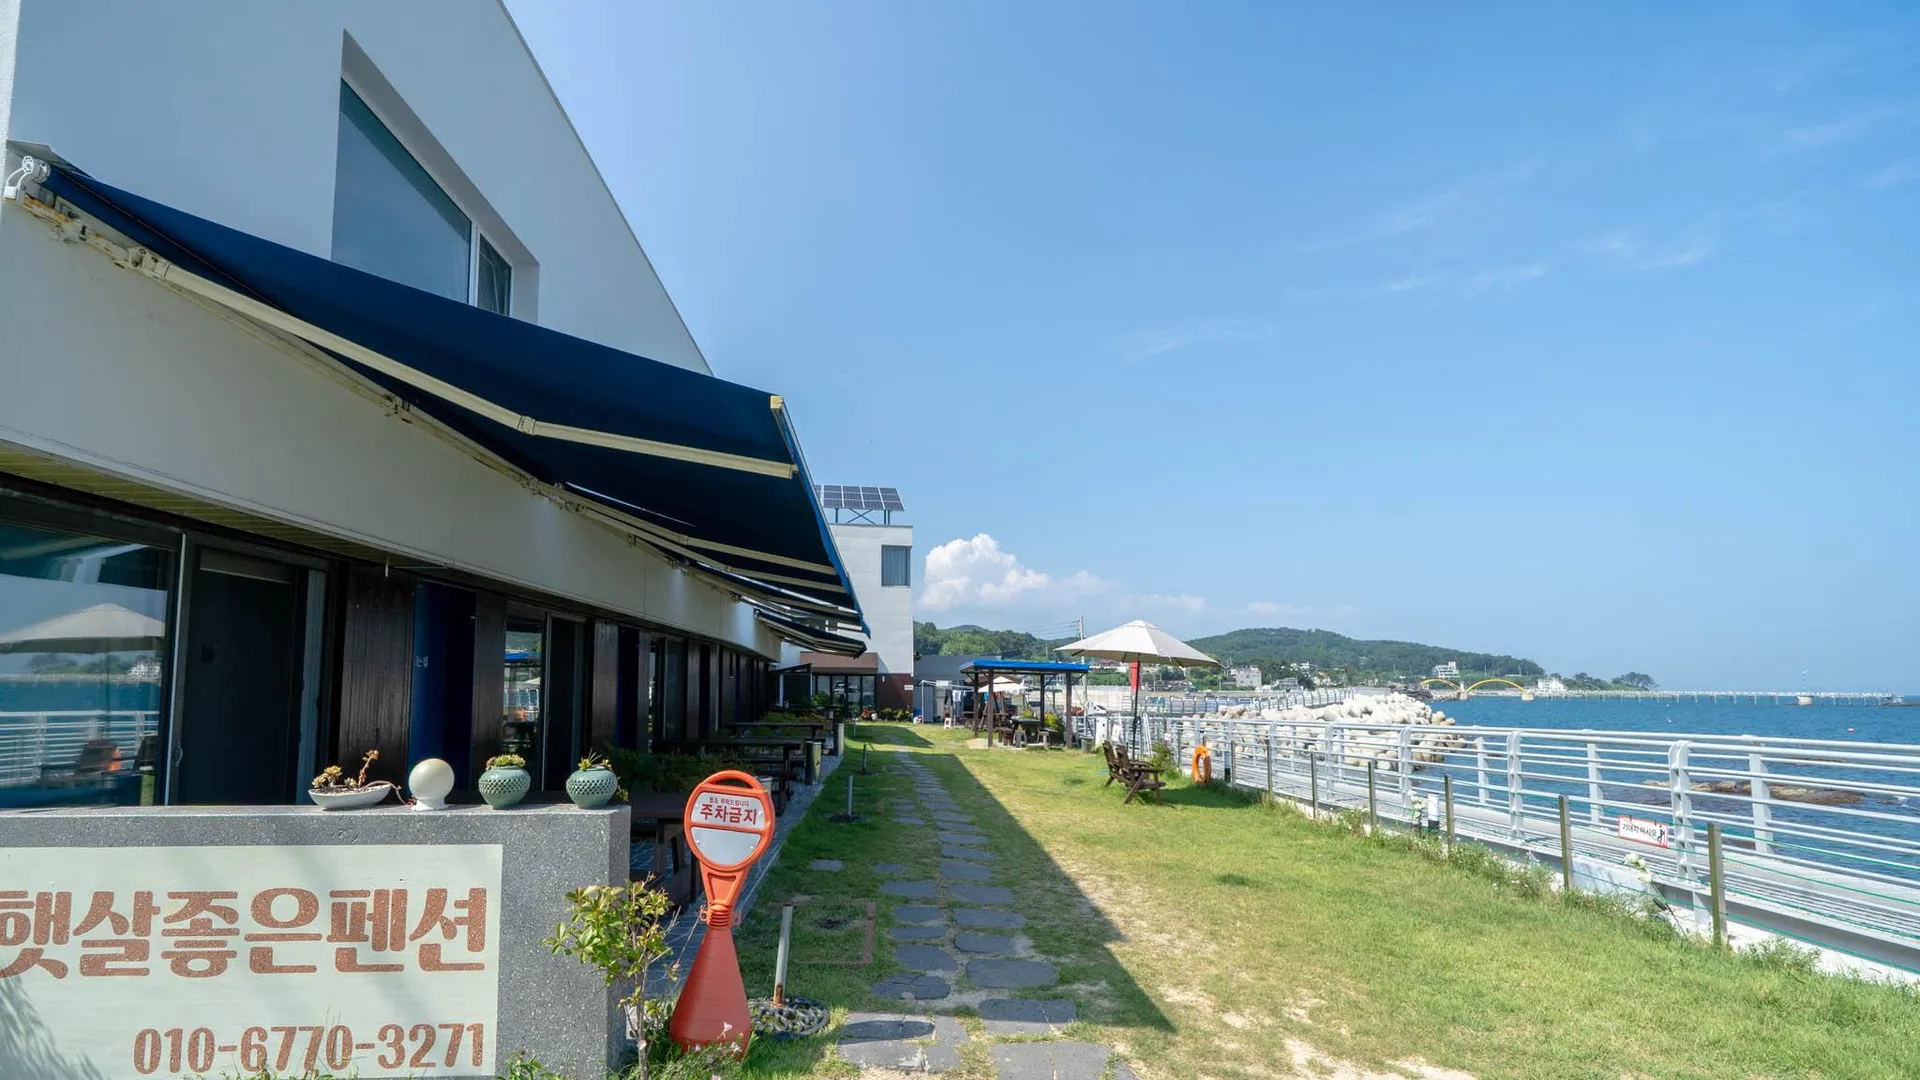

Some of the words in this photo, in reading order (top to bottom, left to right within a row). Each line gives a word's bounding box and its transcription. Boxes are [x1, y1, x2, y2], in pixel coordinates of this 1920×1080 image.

[700, 803, 757, 825] 주차금지
[0, 887, 487, 979] 햇살좋은펜션
[133, 1022, 484, 1075] 010-6770-3271
